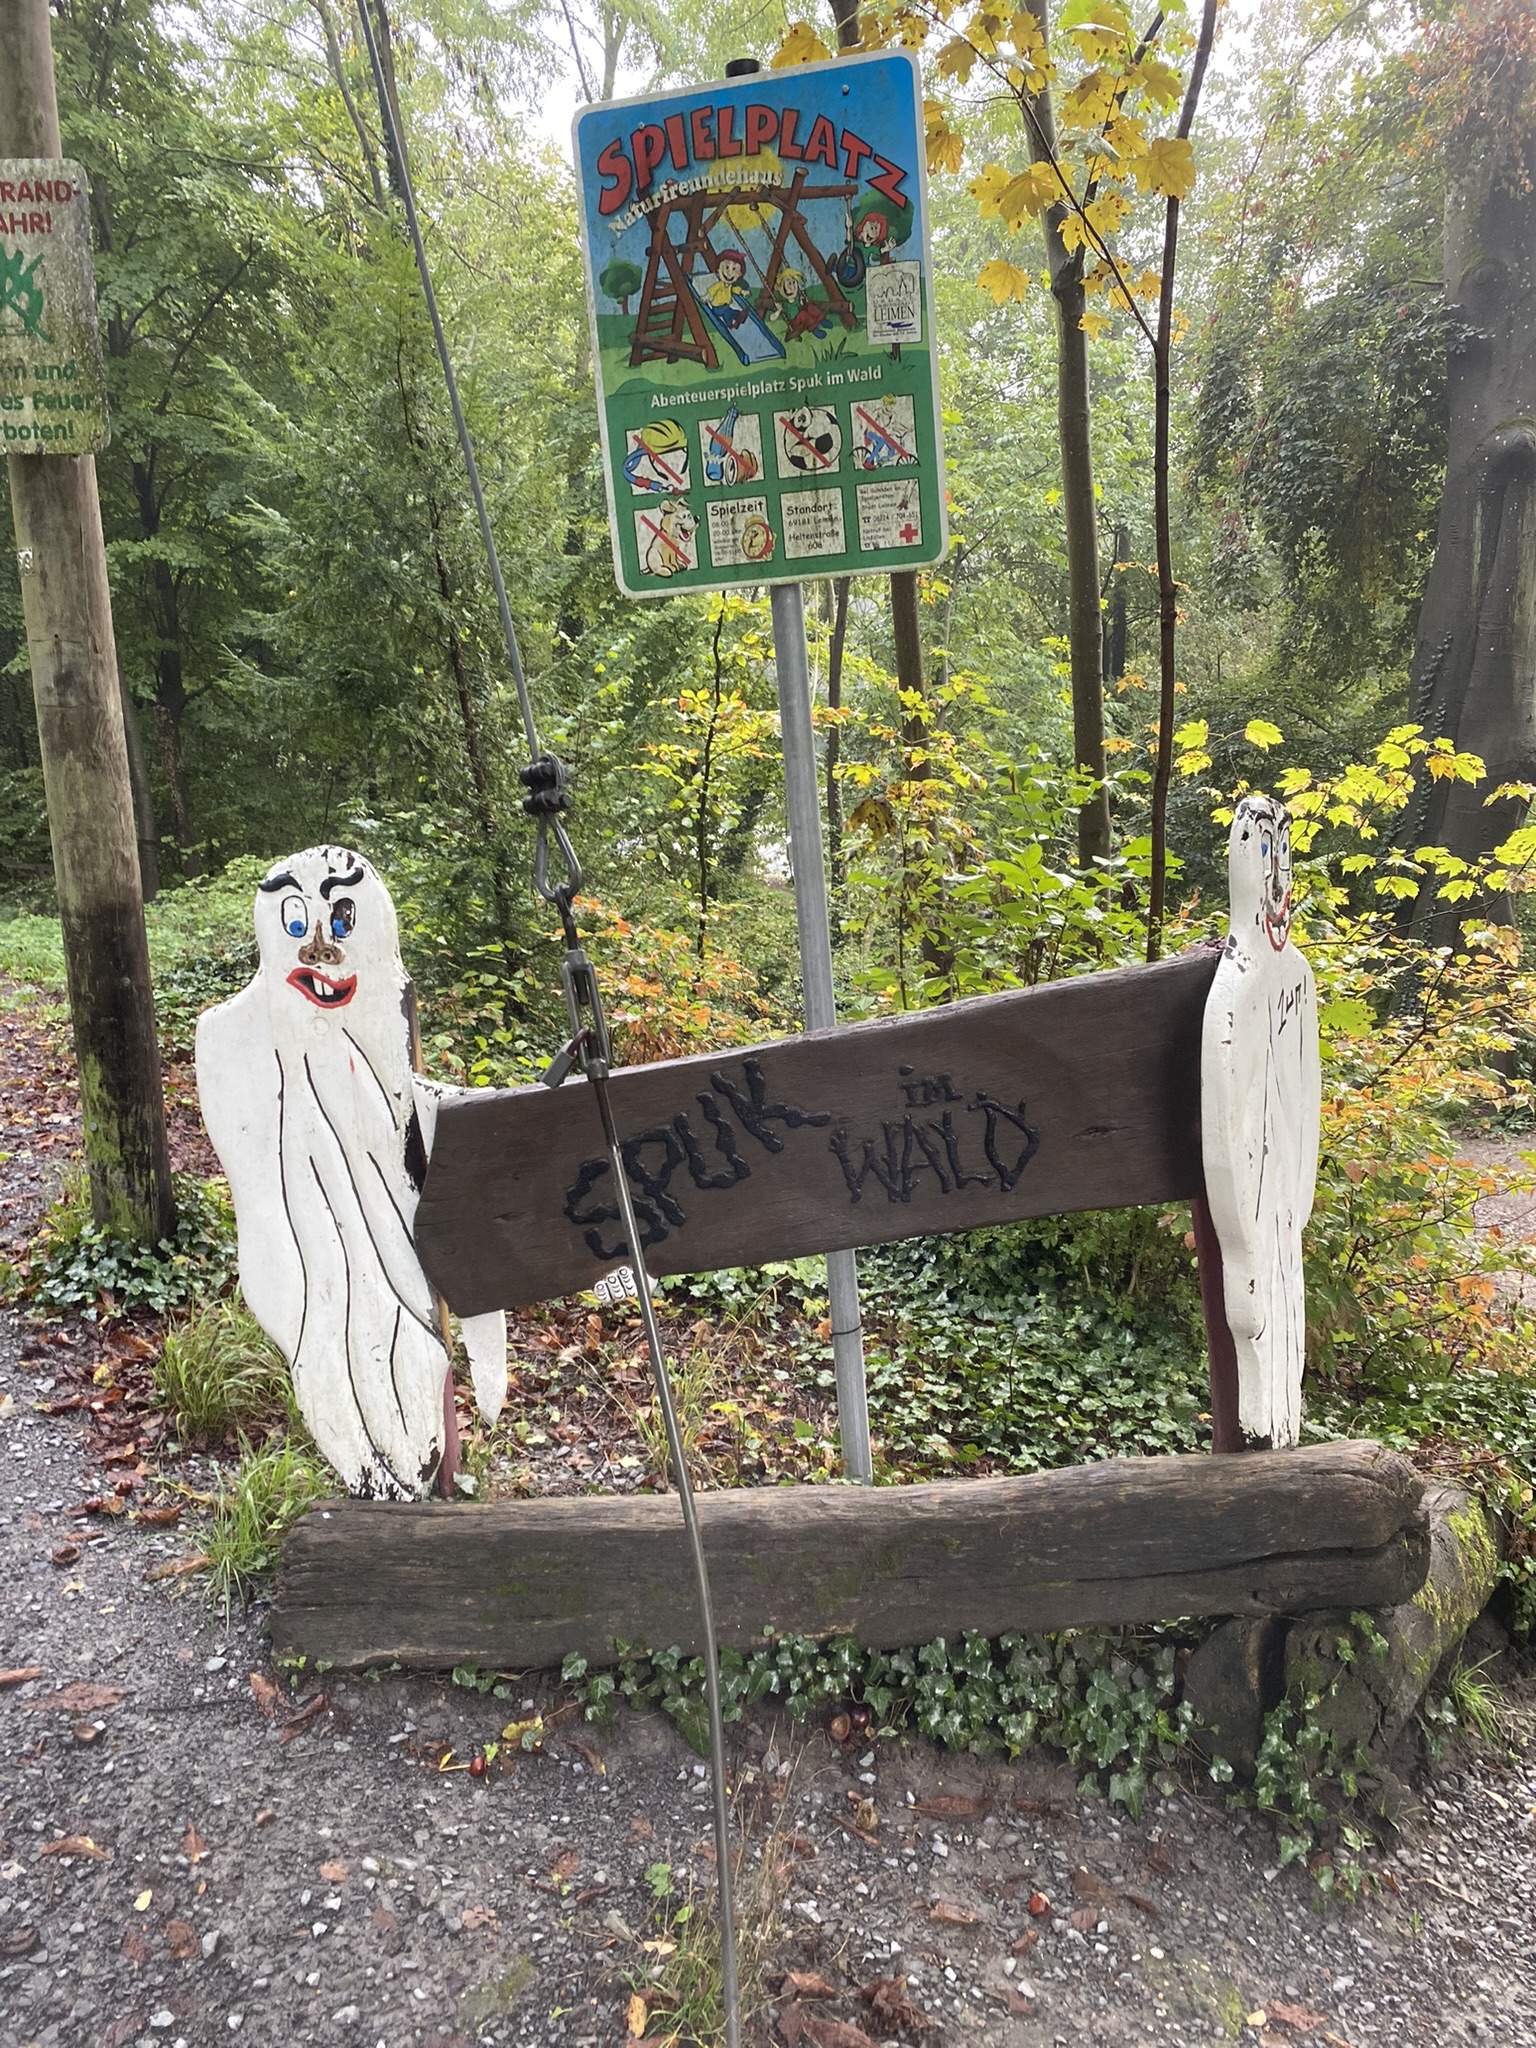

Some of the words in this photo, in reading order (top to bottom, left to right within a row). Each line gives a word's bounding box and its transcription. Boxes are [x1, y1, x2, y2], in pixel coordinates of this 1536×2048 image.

[597, 104, 908, 216] SPIELPLATZ
[608, 165, 784, 239] Naturfreundehaus
[874, 306, 915, 322] LEIMEN
[33, 359, 77, 380] und
[650, 379, 786, 409] Abenteuerspielplatz
[788, 373, 823, 392] Spuk
[826, 371, 844, 386] im
[847, 366, 882, 383] Wald
[32, 390, 93, 410] Feuer
[0, 420, 73, 441] boten!
[710, 500, 764, 519] Spielzeit
[899, 1064, 963, 1107] im
[565, 1058, 832, 1261] SPUK
[829, 1090, 1040, 1203] WALD
